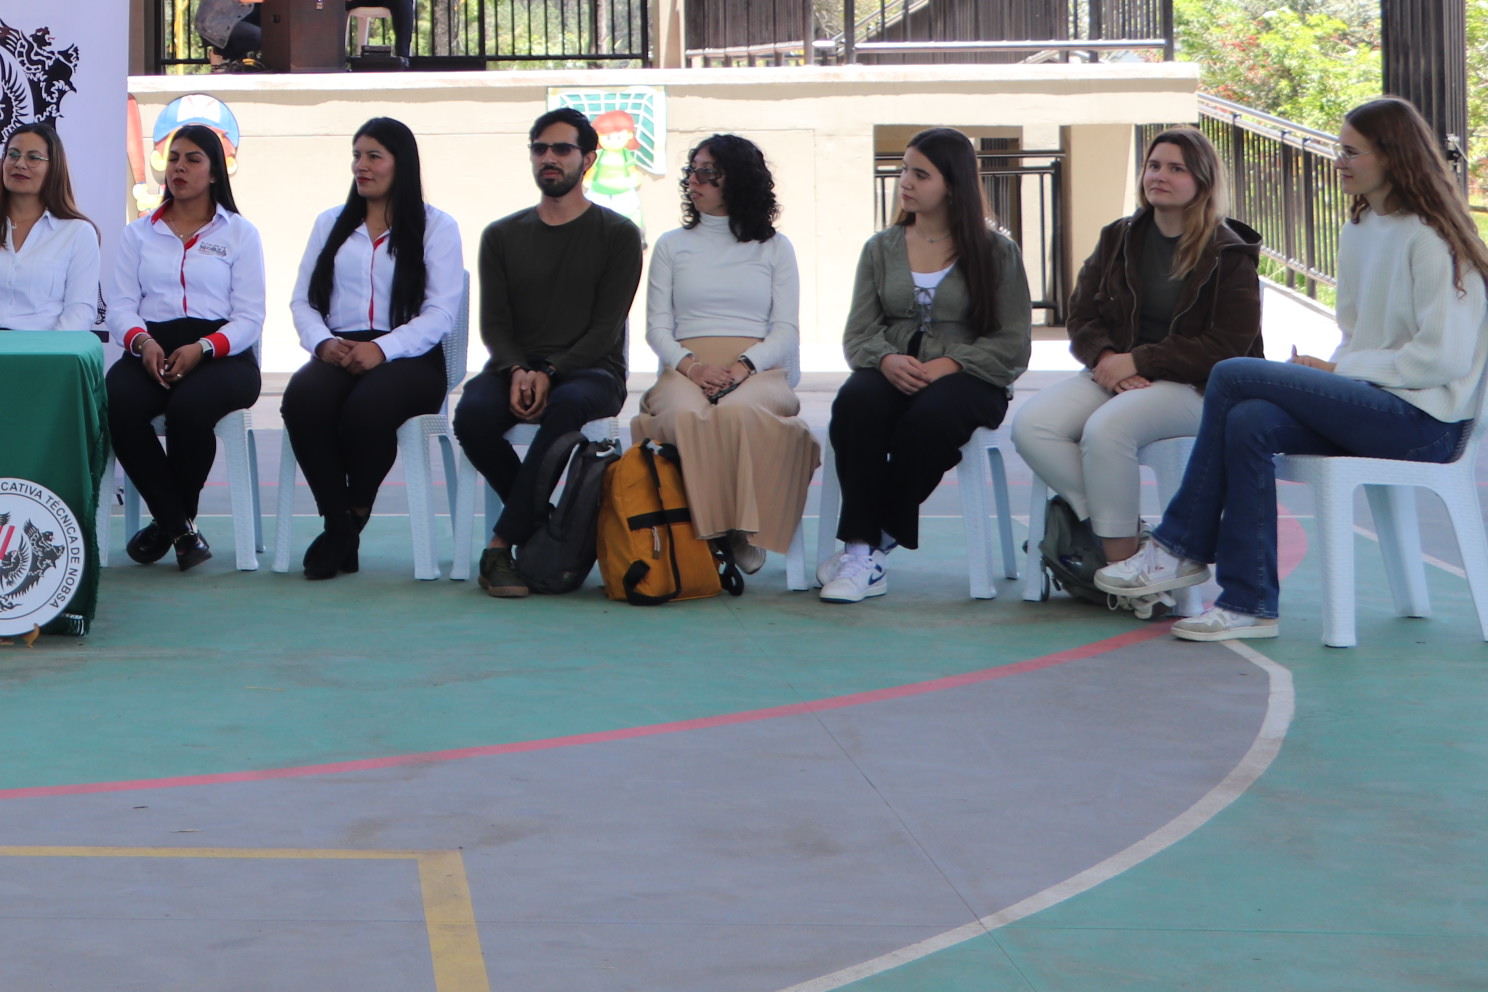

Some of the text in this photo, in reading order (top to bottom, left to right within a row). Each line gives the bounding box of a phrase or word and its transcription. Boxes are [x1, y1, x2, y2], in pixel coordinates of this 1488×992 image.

[46, 496, 79, 545] TÉCNICA
[70, 547, 80, 564] DE
[50, 568, 78, 609] NOBSA
